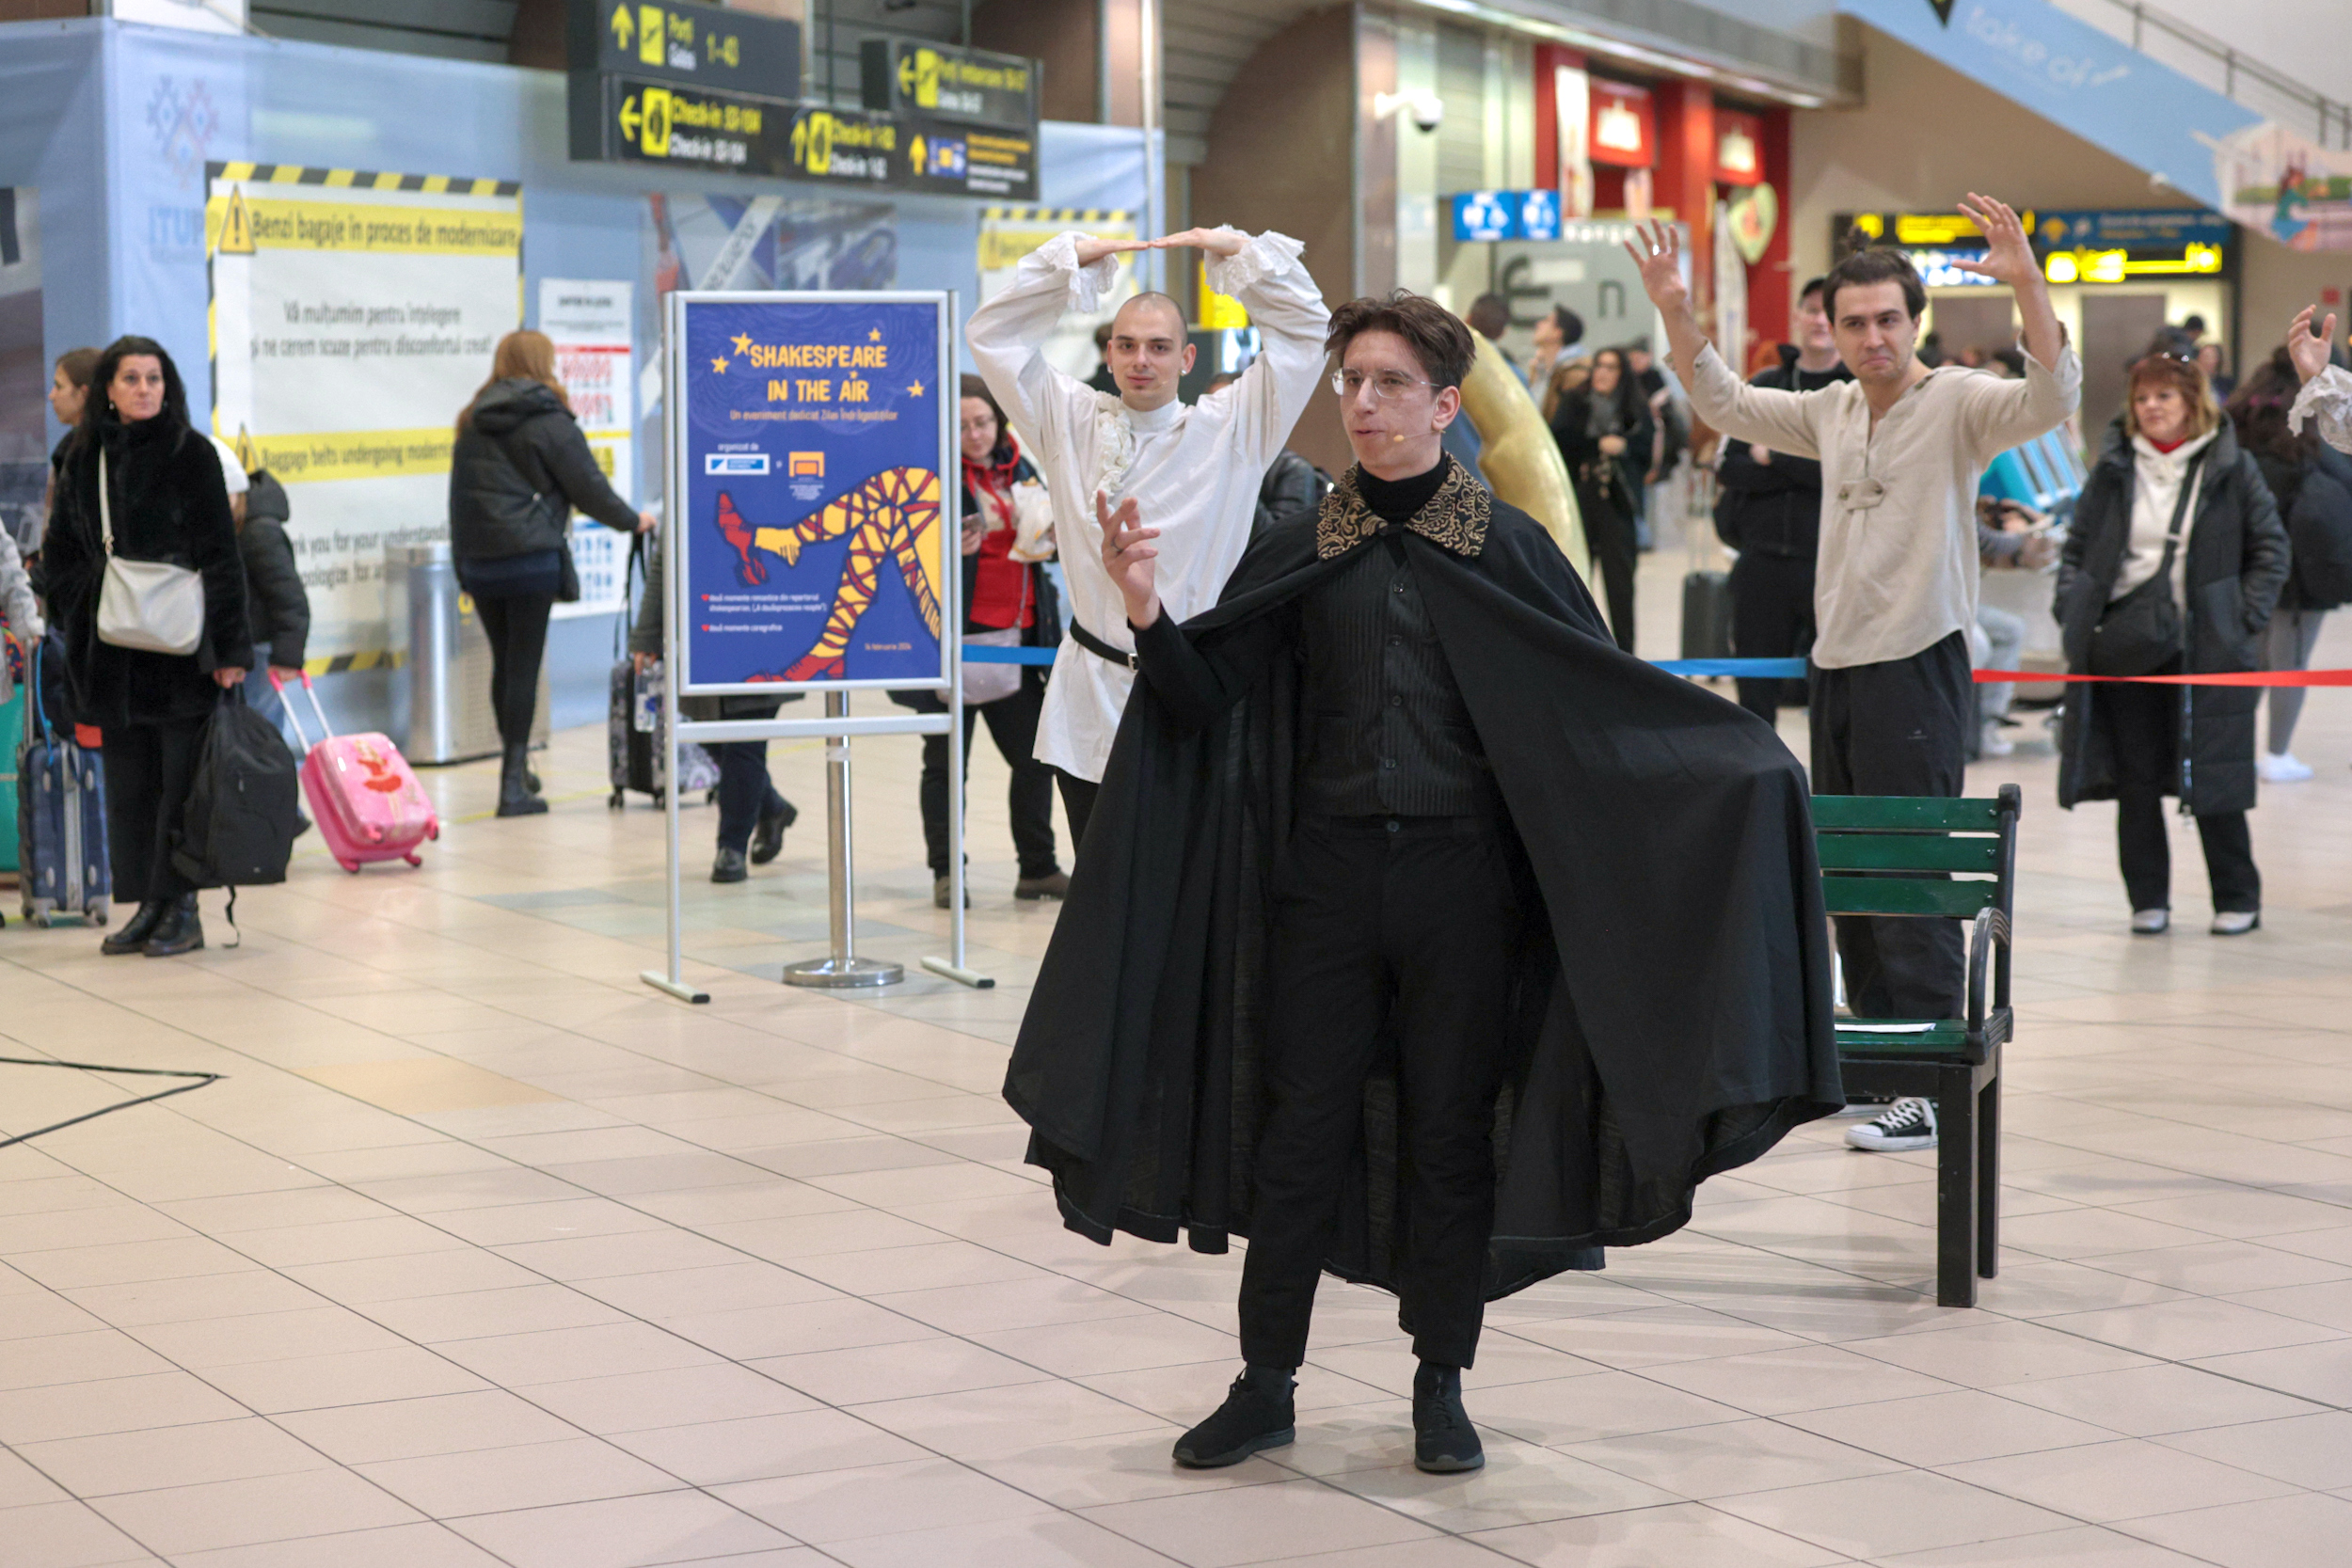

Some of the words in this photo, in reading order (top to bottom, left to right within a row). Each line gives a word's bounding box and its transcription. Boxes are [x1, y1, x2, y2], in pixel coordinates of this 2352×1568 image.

[252, 212, 294, 239] Benzi
[297, 212, 342, 245] bagaje
[366, 221, 411, 246] proces
[416, 217, 432, 245] de
[436, 219, 516, 247] modernizare
[367, 306, 405, 327] pentru
[262, 338, 277, 356] ne
[279, 339, 315, 356] cerem
[319, 339, 351, 356] scuze
[354, 337, 390, 360] pentru
[750, 344, 887, 368] SHAKESPEARE
[767, 379, 788, 402] IN
[795, 379, 831, 402] THE
[838, 379, 869, 402] AIR
[730, 409, 741, 420] Un
[743, 410, 787, 421] eveniment
[788, 409, 819, 420] dedicat
[310, 535, 329, 559] you
[334, 528, 349, 551] for
[355, 531, 377, 555] your
